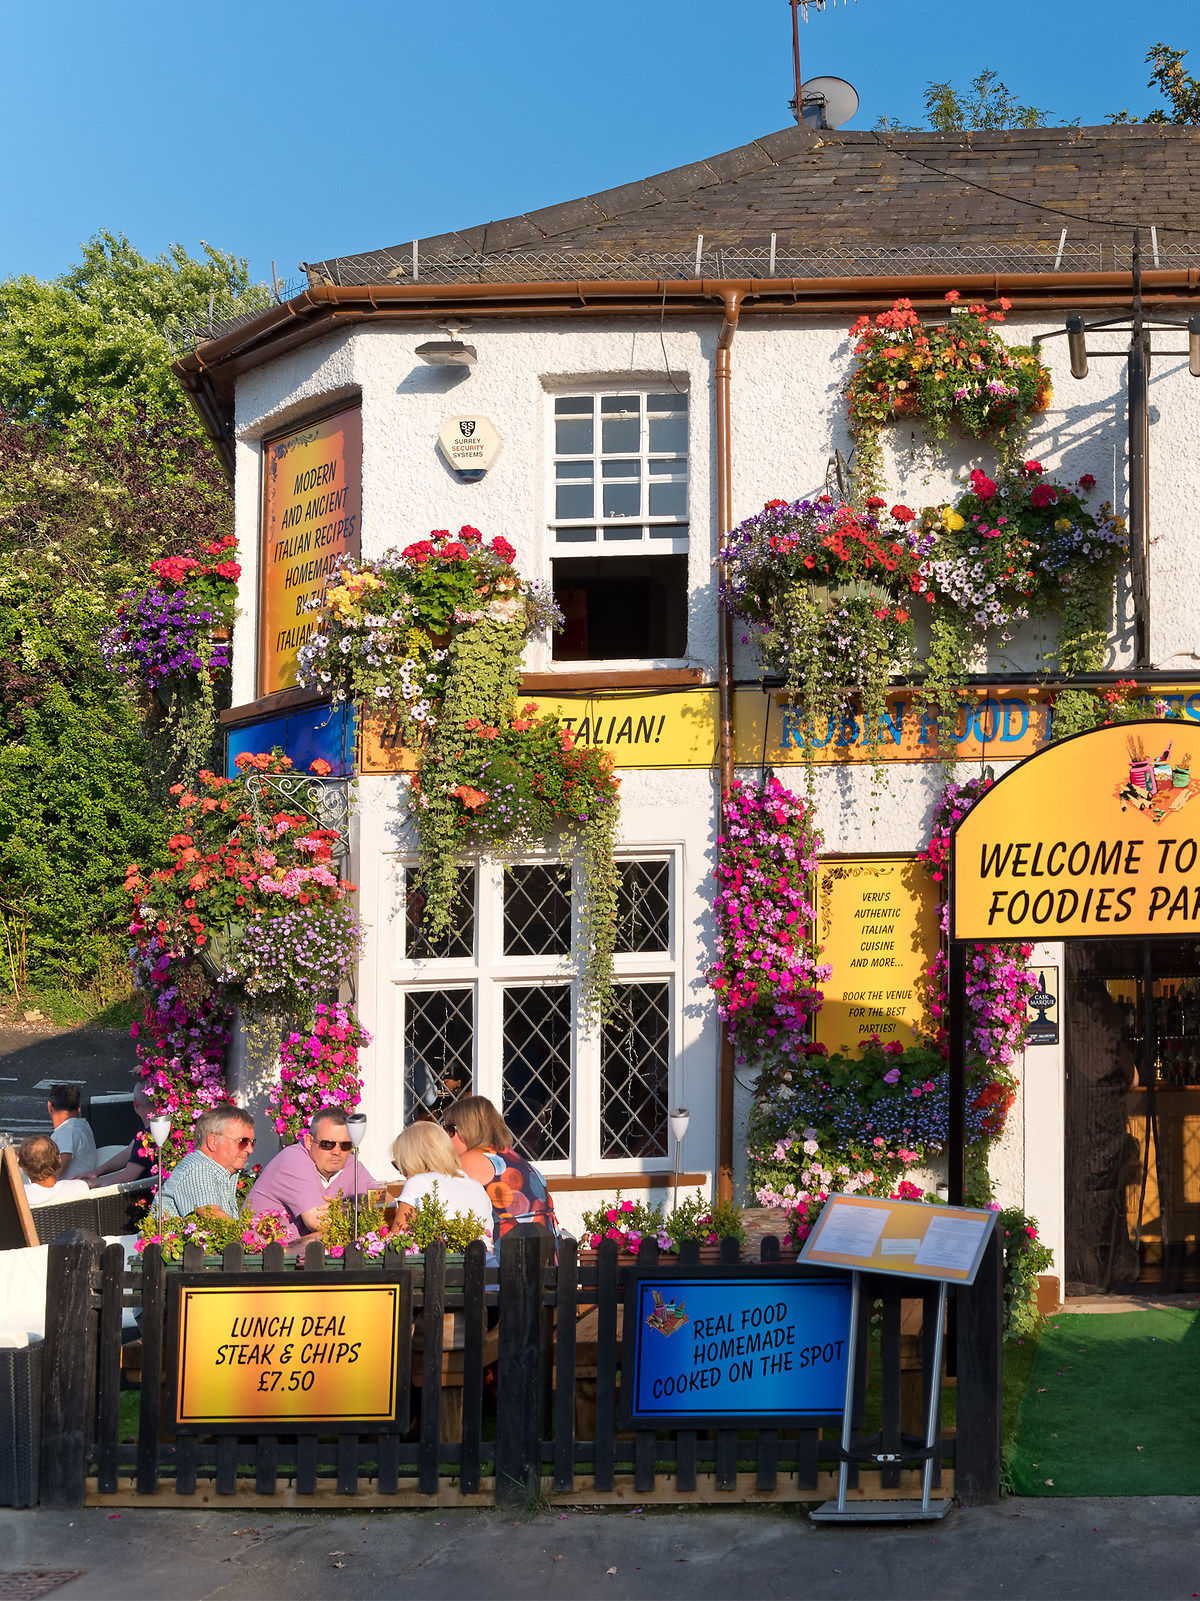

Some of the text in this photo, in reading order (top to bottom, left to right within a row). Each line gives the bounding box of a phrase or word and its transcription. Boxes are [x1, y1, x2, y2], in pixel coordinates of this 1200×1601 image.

[451, 444, 484, 452] SECURITY
[293, 460, 337, 495] MODERN
[281, 486, 350, 531] AND ANCIENT
[273, 514, 357, 563] ITALIAN RECIPES
[284, 551, 342, 590] HOMEMADE
[276, 622, 314, 653] ITALIAN
[554, 715, 666, 745] TALIAN!
[980, 839, 1144, 879] WELCOME
[1158, 837, 1198, 874] TO
[862, 892, 890, 902] VERU'S
[987, 886, 1136, 926] FOODIES
[854, 908, 901, 919] AUTHENTIC
[861, 925, 894, 935] ITALIAN
[860, 941, 894, 951] CUISINE
[850, 957, 904, 968] AND MORE...
[842, 989, 912, 1001] BOOK THE VENUE
[848, 1006, 906, 1018] FOR THE BEST
[858, 1023, 897, 1034] PARTIES!
[231, 1315, 346, 1338] LUNCH DEAL
[693, 1302, 788, 1340] REAL FOOD
[215, 1342, 362, 1365] STEAK & CHIPS
[693, 1325, 796, 1366] HOMEMADE
[257, 1370, 315, 1392] £7.50
[652, 1340, 845, 1399] COOKED ON THE SPOT
